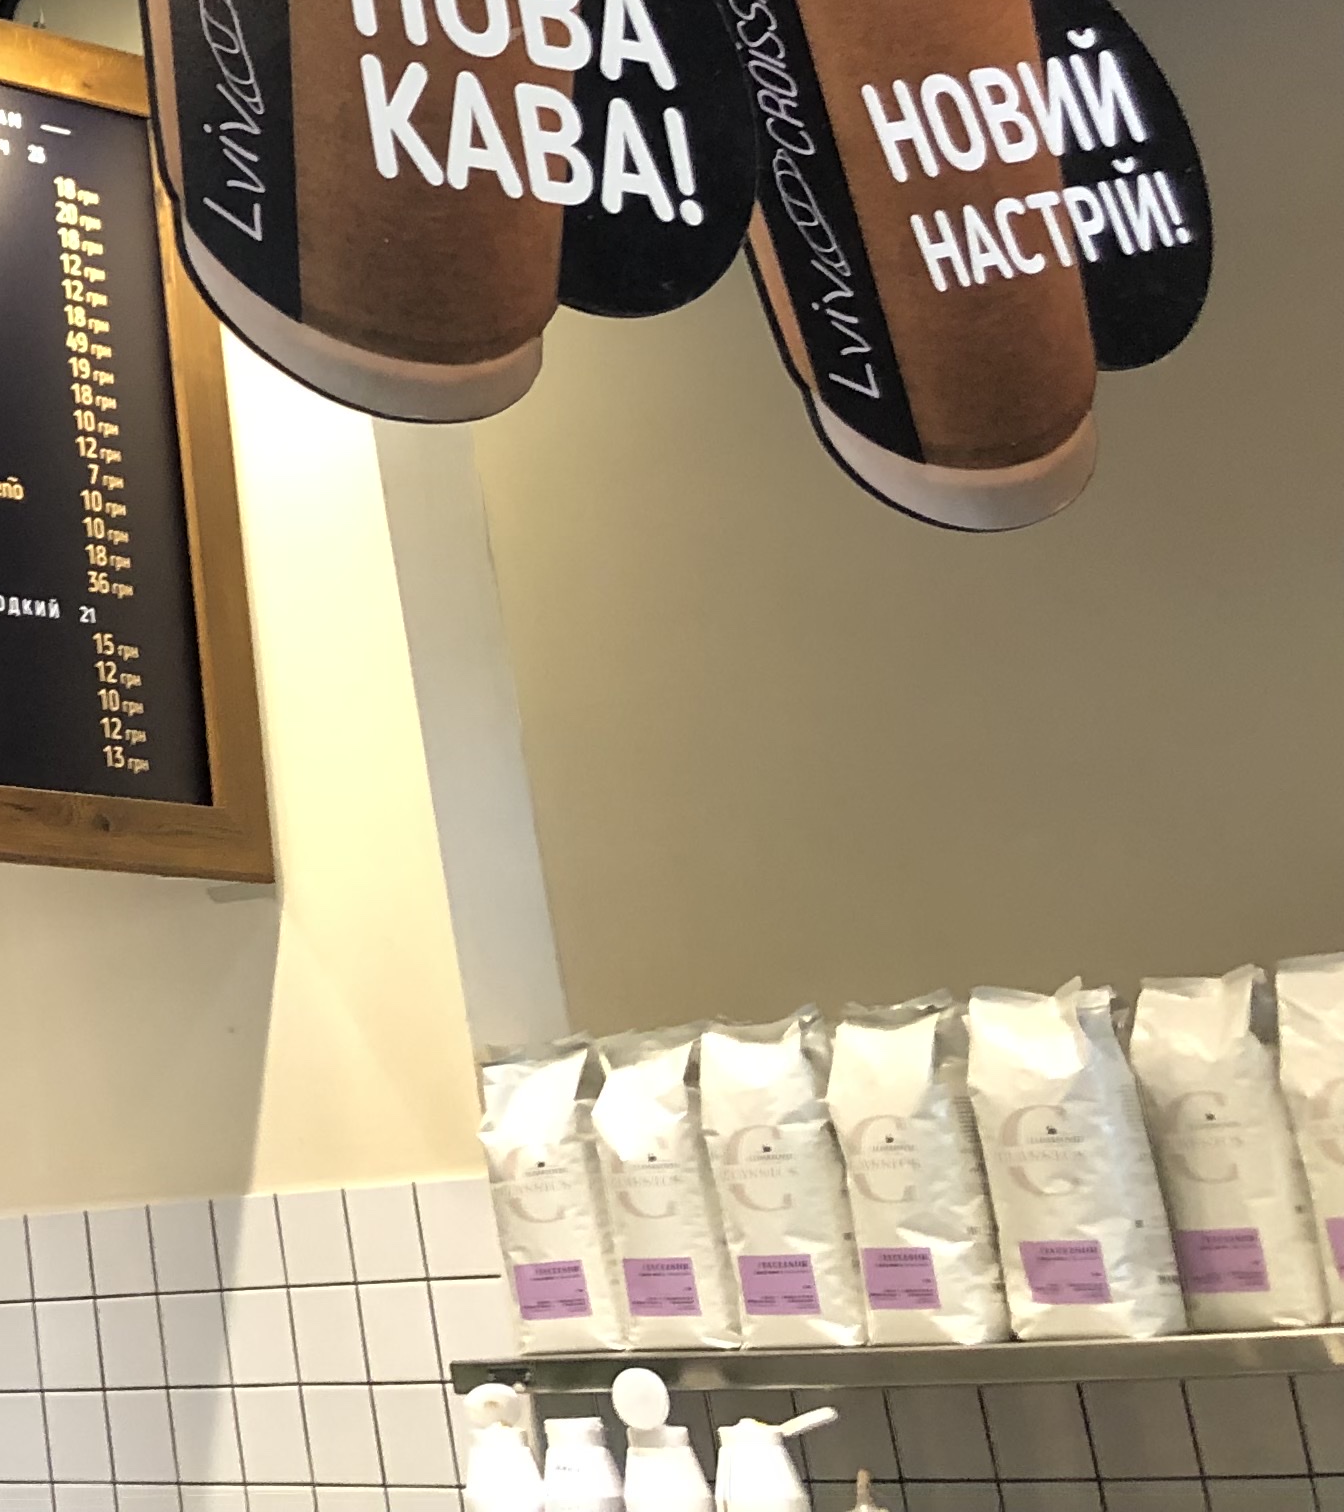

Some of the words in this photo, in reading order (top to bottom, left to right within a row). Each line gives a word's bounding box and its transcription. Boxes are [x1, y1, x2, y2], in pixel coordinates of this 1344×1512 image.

[861, 28, 1146, 183] НОВИЙ
[360, 54, 703, 226] КАВА!
[910, 157, 1191, 292] НАСТРІЙ!
[65, 329, 89, 353] 49
[67, 356, 91, 379] 19
[70, 382, 93, 405] 18
[75, 435, 98, 459] 12
[87, 463, 99, 484] 7
[87, 570, 110, 594] 36
[79, 605, 96, 623] 21
[92, 632, 114, 655] 15
[102, 744, 124, 768] 13
